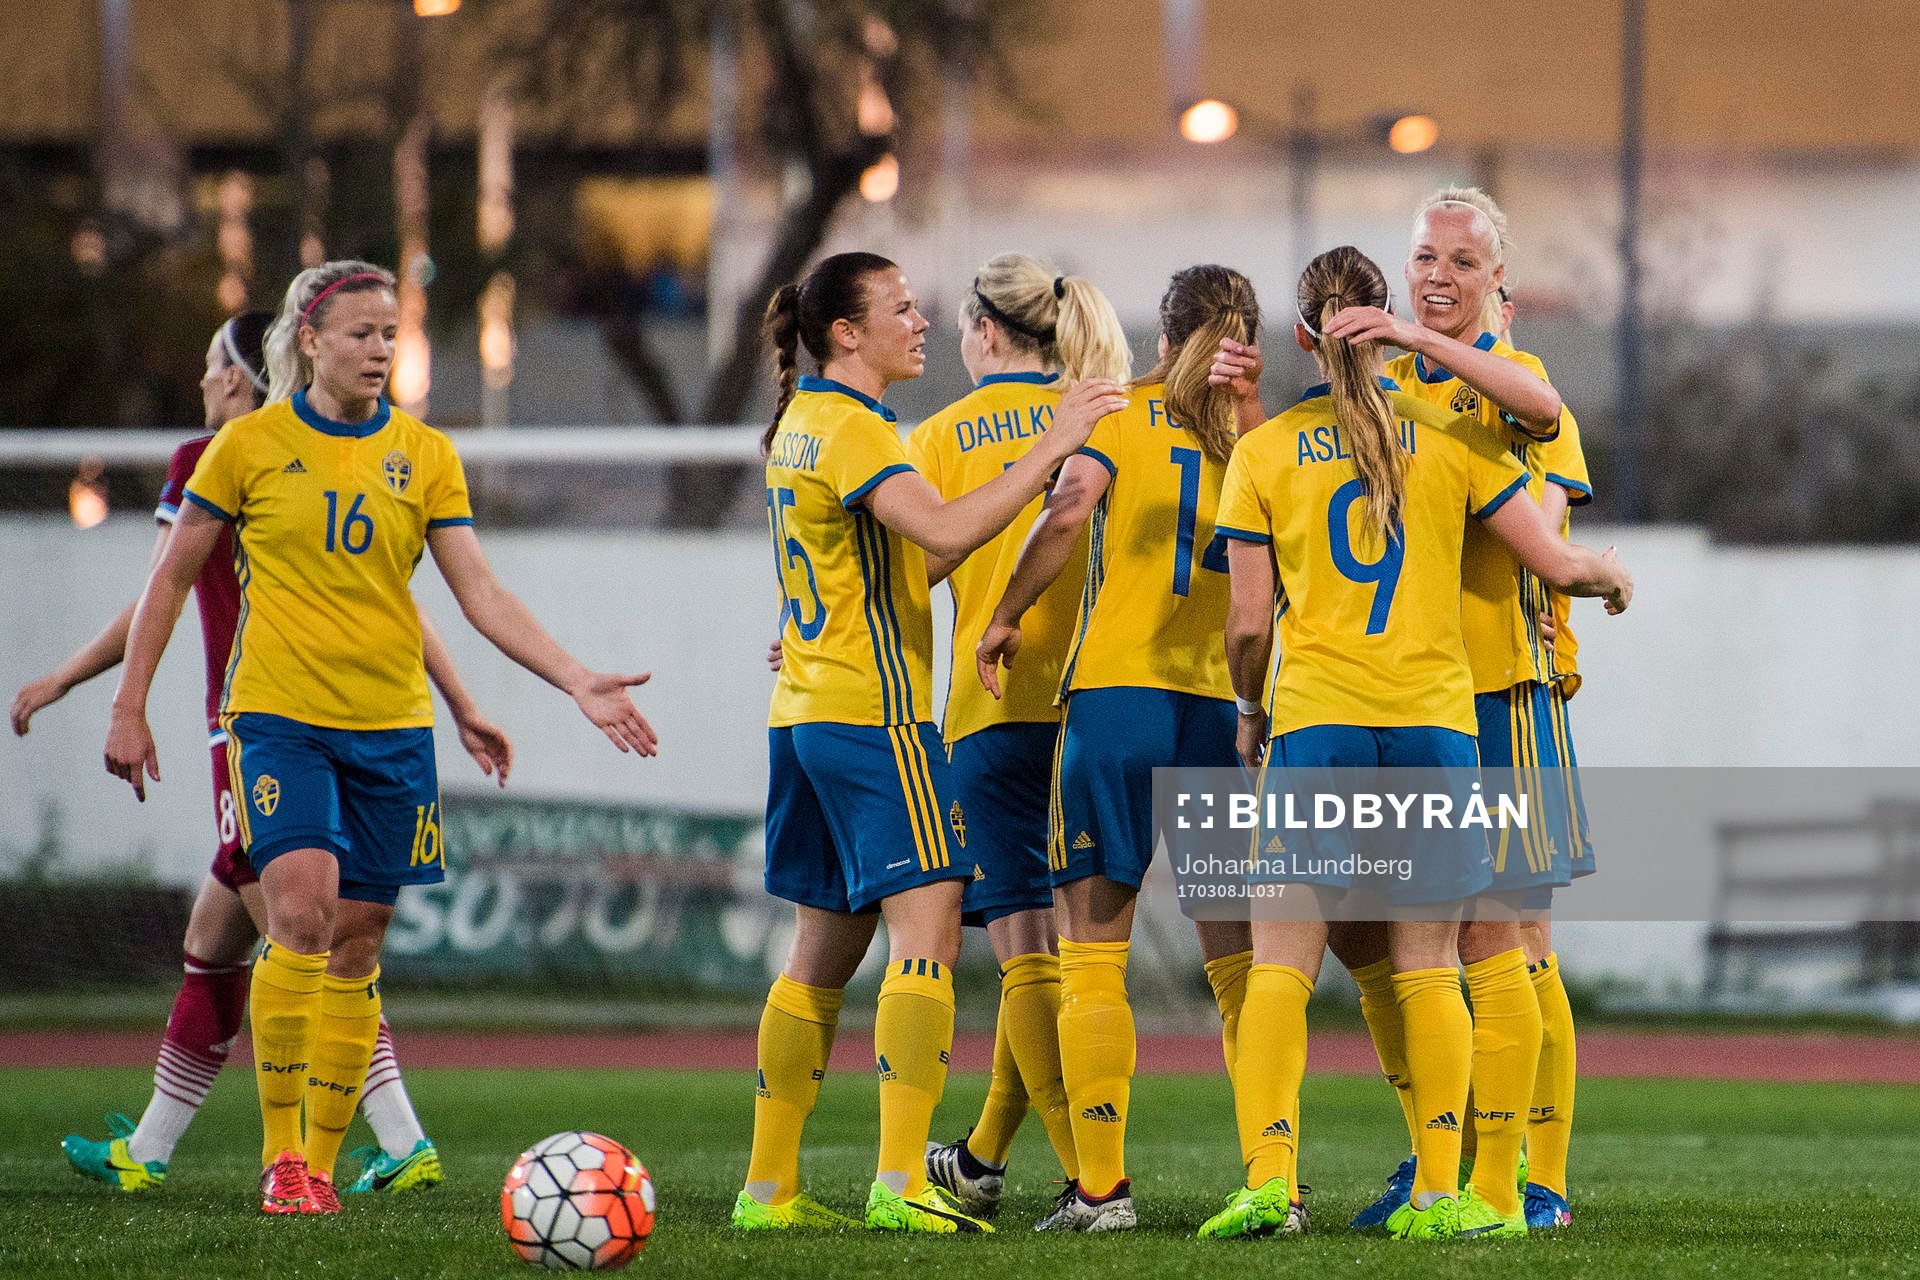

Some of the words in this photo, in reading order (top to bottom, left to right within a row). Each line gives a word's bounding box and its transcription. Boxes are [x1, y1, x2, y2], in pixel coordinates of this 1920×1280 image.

[323, 490, 375, 555] 16
[767, 487, 827, 641] 15
[1328, 477, 1405, 635] 9
[219, 789, 236, 845] 8
[410, 801, 439, 867] 16
[308, 1076, 357, 1097] SvFF
[1081, 1111, 1122, 1123] adidas
